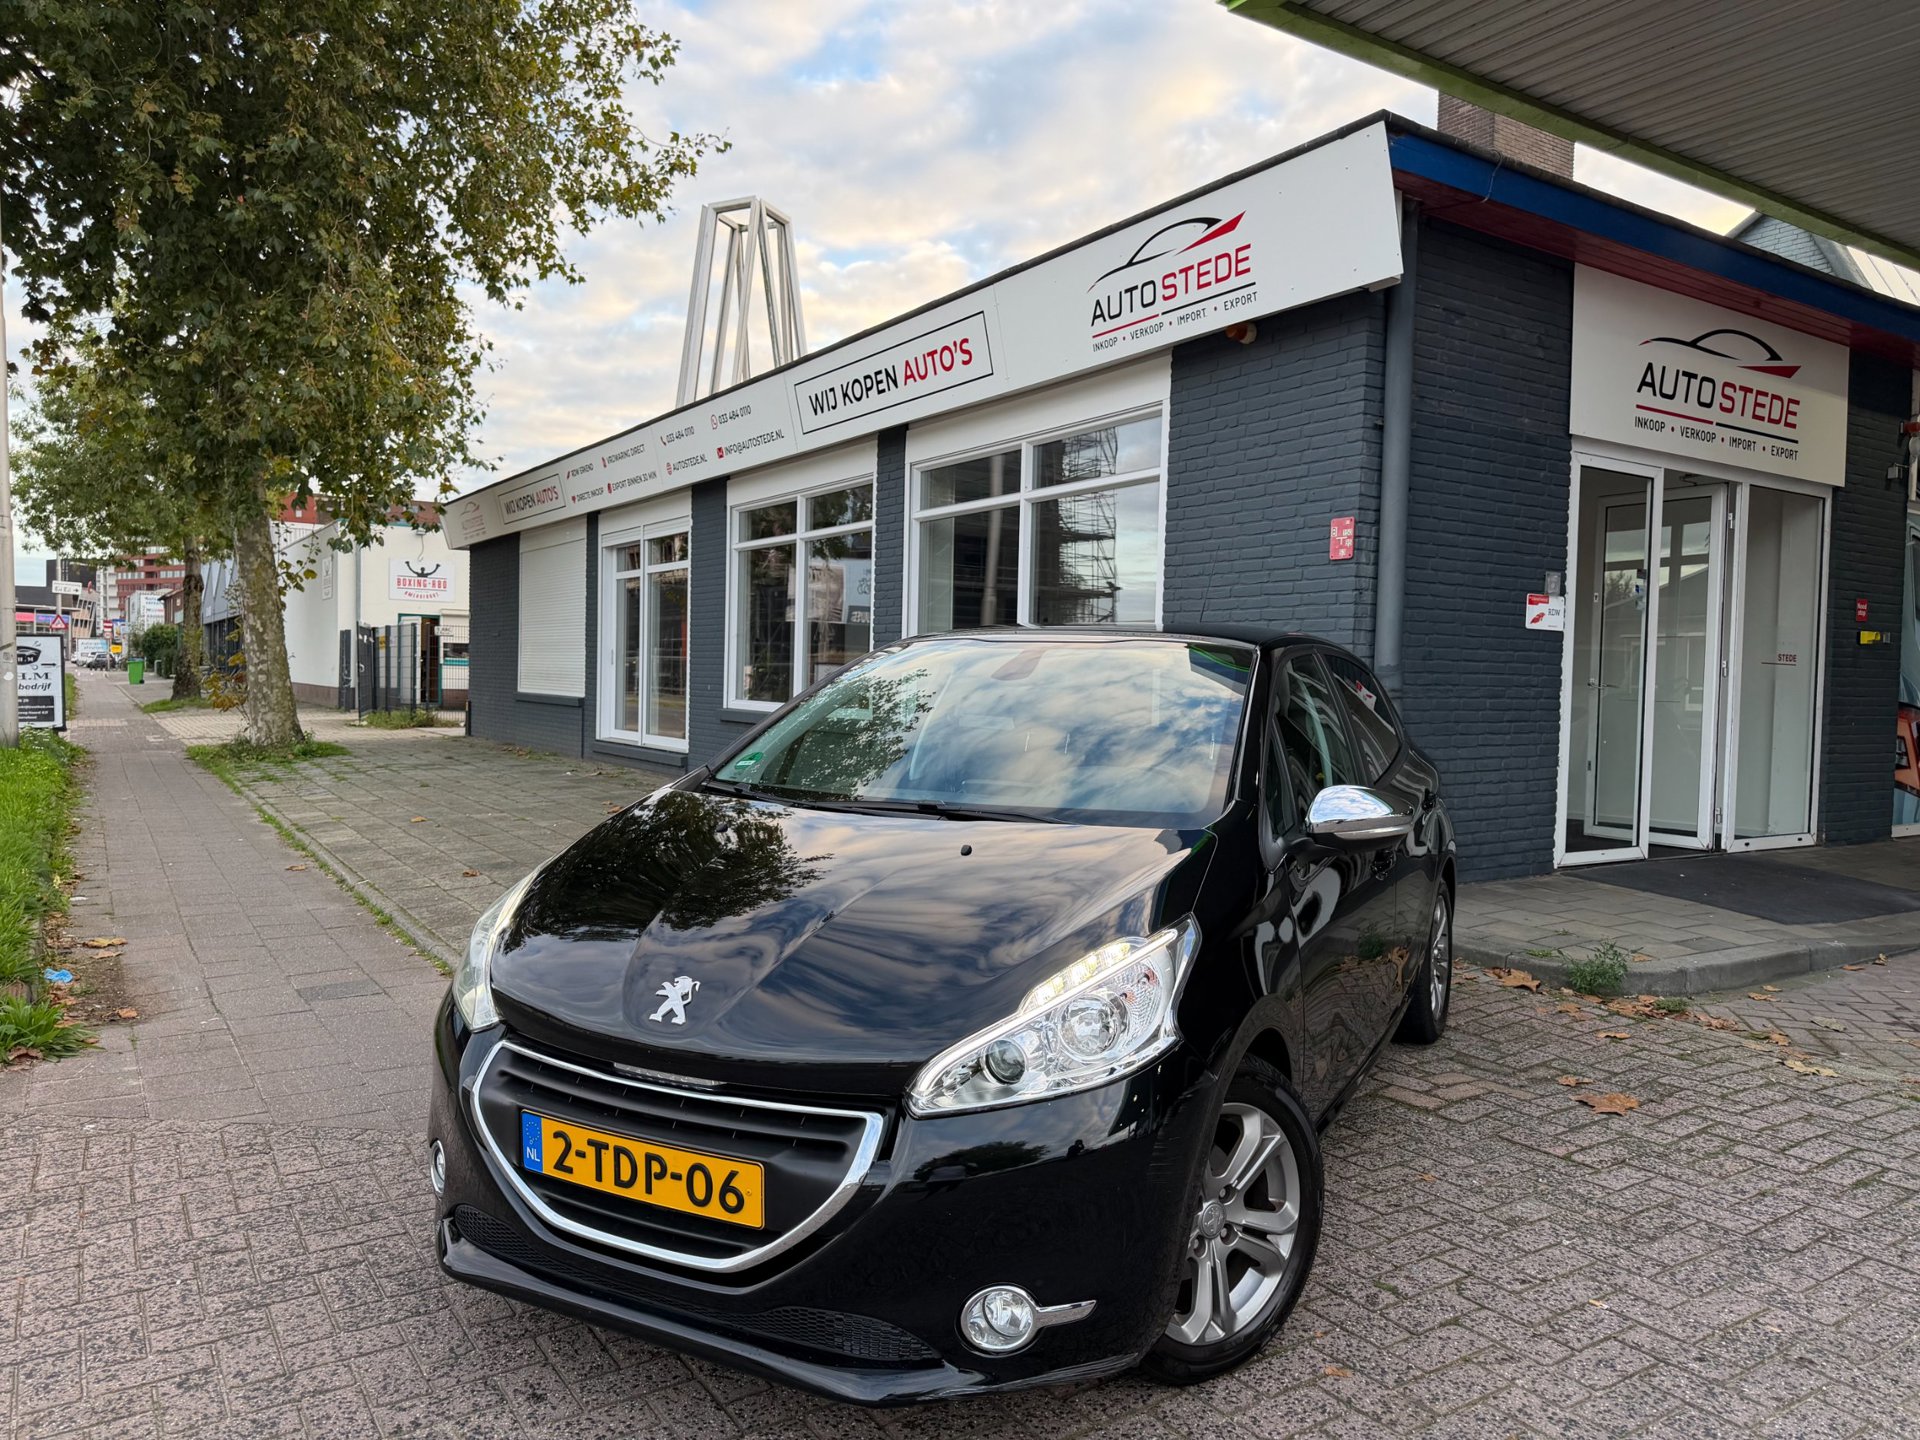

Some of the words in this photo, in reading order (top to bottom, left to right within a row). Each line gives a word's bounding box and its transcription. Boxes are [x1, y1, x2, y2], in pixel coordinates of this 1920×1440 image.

[1092, 336, 1118, 352] INKOOP
[1130, 321, 1164, 341] VERKOOP
[1177, 308, 1207, 326] IMPORT
[1223, 291, 1258, 311] EXPORT
[809, 388, 837, 416] WIJ
[840, 365, 899, 406] KOPEN
[904, 337, 973, 386] AUTO'S
[718, 413, 728, 424] 033
[729, 410, 740, 420] 484
[724, 429, 784, 455] INFO@AUTOSTEDE.NL
[1634, 415, 1666, 433] INKOOP
[1680, 425, 1716, 443] VERKOOP
[1729, 436, 1757, 452] IMPORT
[1770, 445, 1798, 461] EXPORT
[630, 444, 646, 457] DIRECT
[672, 454, 707, 471] AUTOSTEDE.NL
[612, 479, 627, 491] EXPORT
[504, 500, 516, 515] WIJ
[515, 492, 537, 512] KOPEN
[1548, 608, 1560, 616] RDW
[526, 1146, 541, 1162] NL
[552, 1130, 745, 1214] 2-TDP-06
